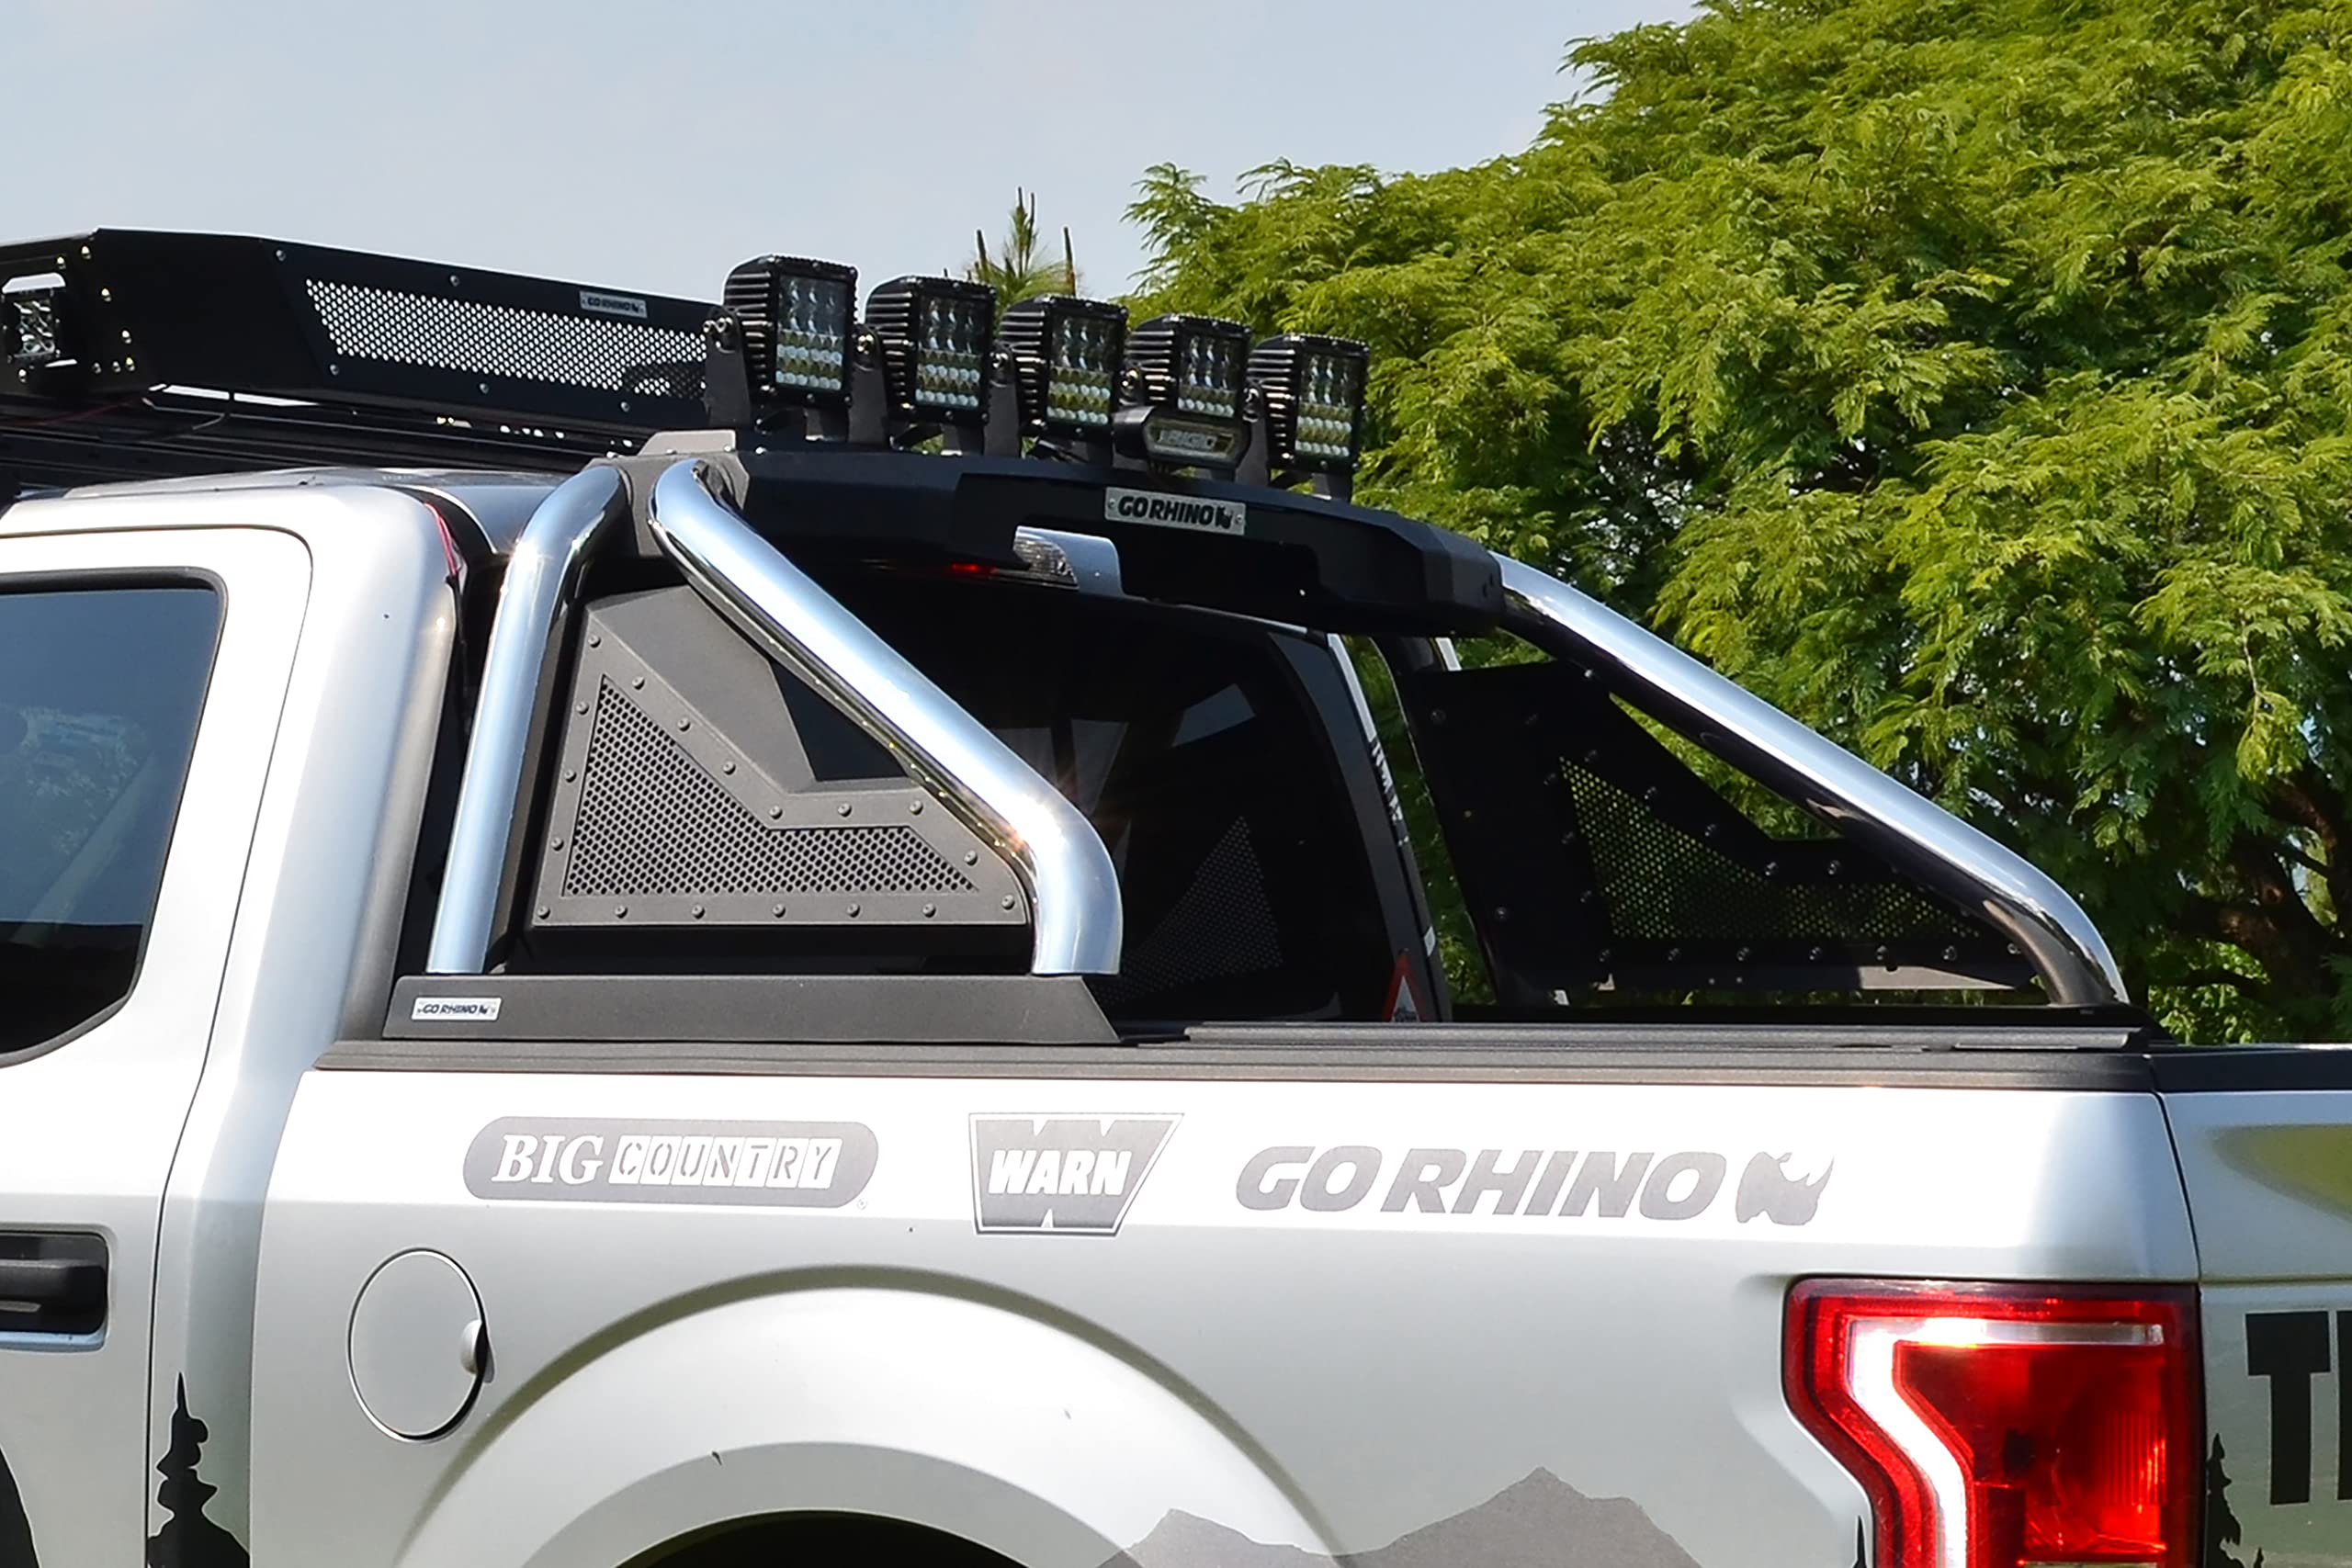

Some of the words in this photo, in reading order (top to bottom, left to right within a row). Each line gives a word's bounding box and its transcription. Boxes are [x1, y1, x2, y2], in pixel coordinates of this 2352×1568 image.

[1117, 495, 1148, 518] GO
[1148, 499, 1215, 526] RHINO
[491, 1134, 605, 1185] BIG
[610, 1136, 840, 1188] COUNTRY
[988, 1149, 1133, 1196] WARN
[1236, 1145, 1383, 1212] GO
[1380, 1148, 1727, 1221] RHINO
